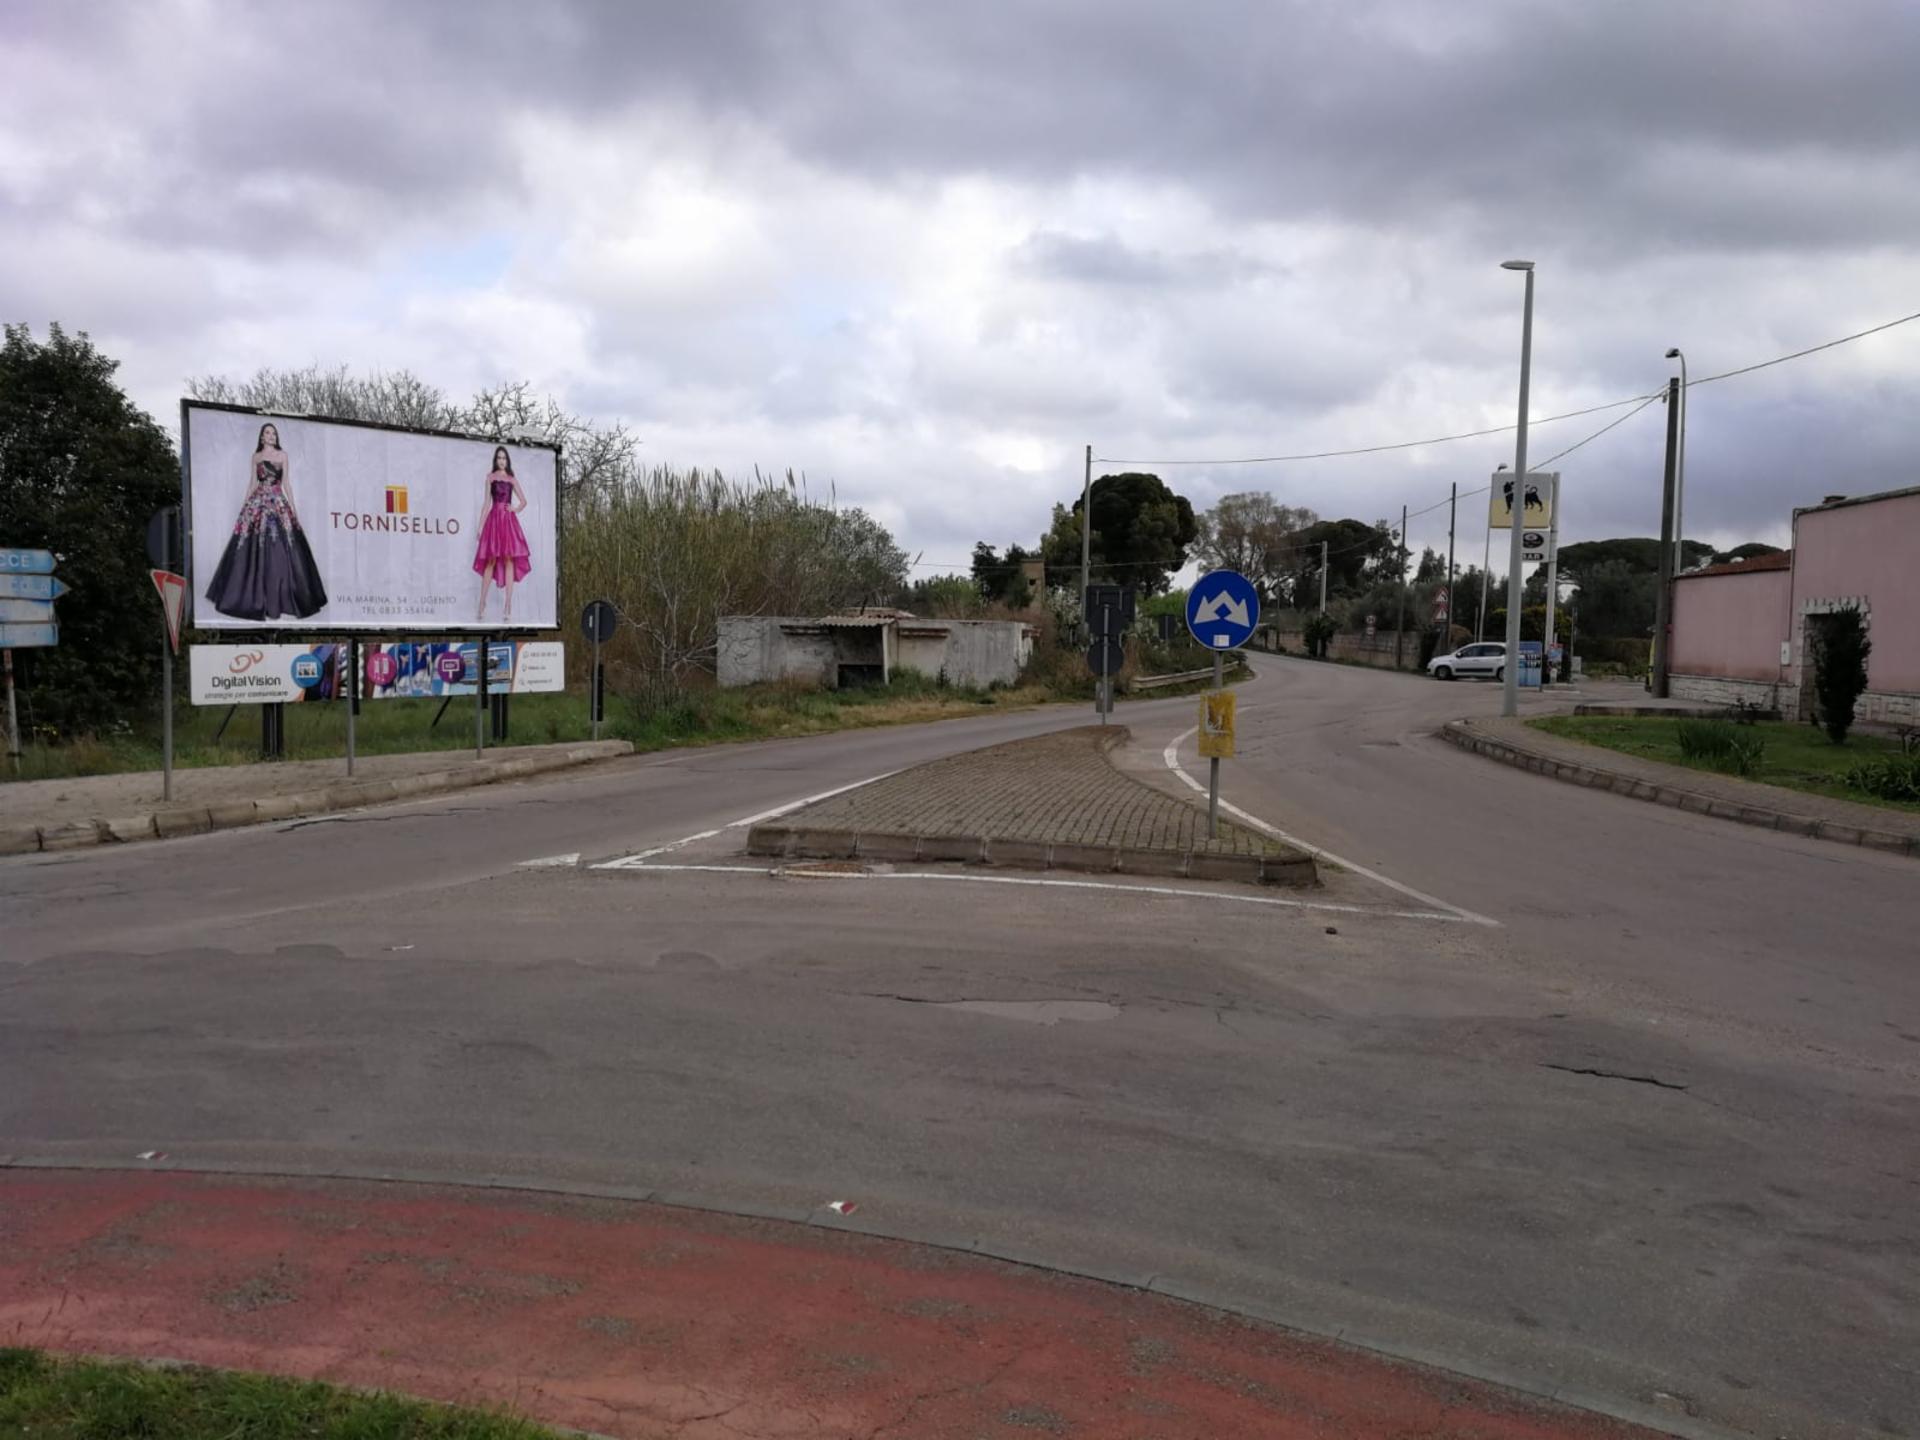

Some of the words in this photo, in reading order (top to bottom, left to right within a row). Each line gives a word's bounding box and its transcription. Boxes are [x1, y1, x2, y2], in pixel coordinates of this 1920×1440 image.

[330, 512, 460, 535] TORNISELLO
[336, 594, 352, 603] VIA
[420, 596, 457, 605] UGENTO
[212, 676, 246, 690] Digital
[247, 675, 281, 687] Vision
[247, 690, 288, 698] comunicare
